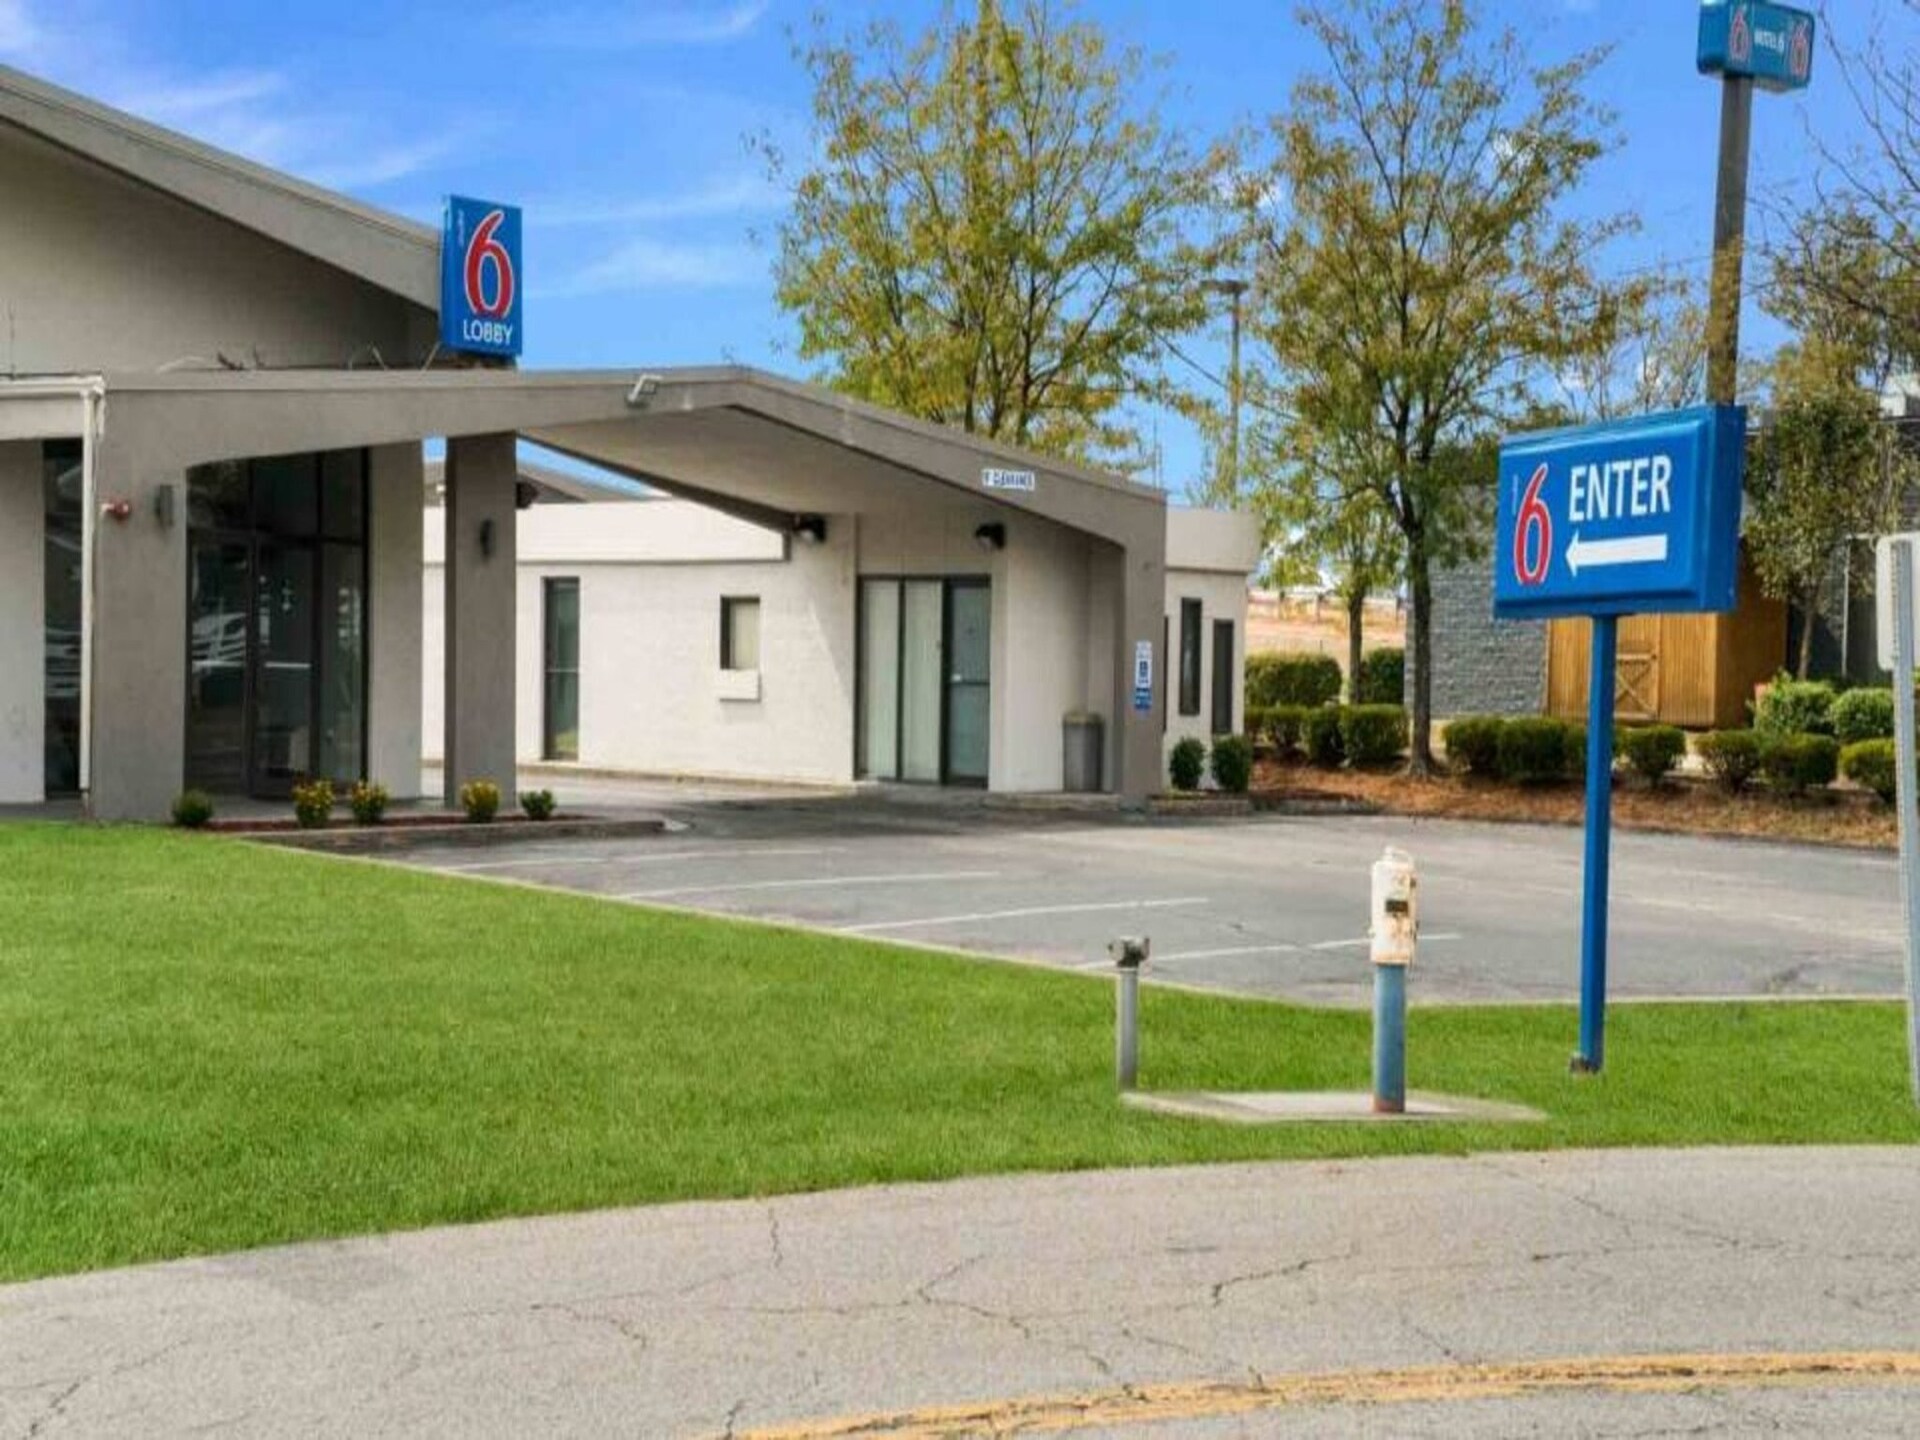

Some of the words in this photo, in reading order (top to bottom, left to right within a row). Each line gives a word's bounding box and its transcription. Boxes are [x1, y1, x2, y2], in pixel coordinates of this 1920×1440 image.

[1729, 4, 1750, 61] 6
[1790, 20, 1810, 77] 6
[464, 210, 514, 318] 6
[463, 319, 513, 345] LOBBY
[1570, 455, 1672, 522] ENTER
[1514, 462, 1552, 585] 6
